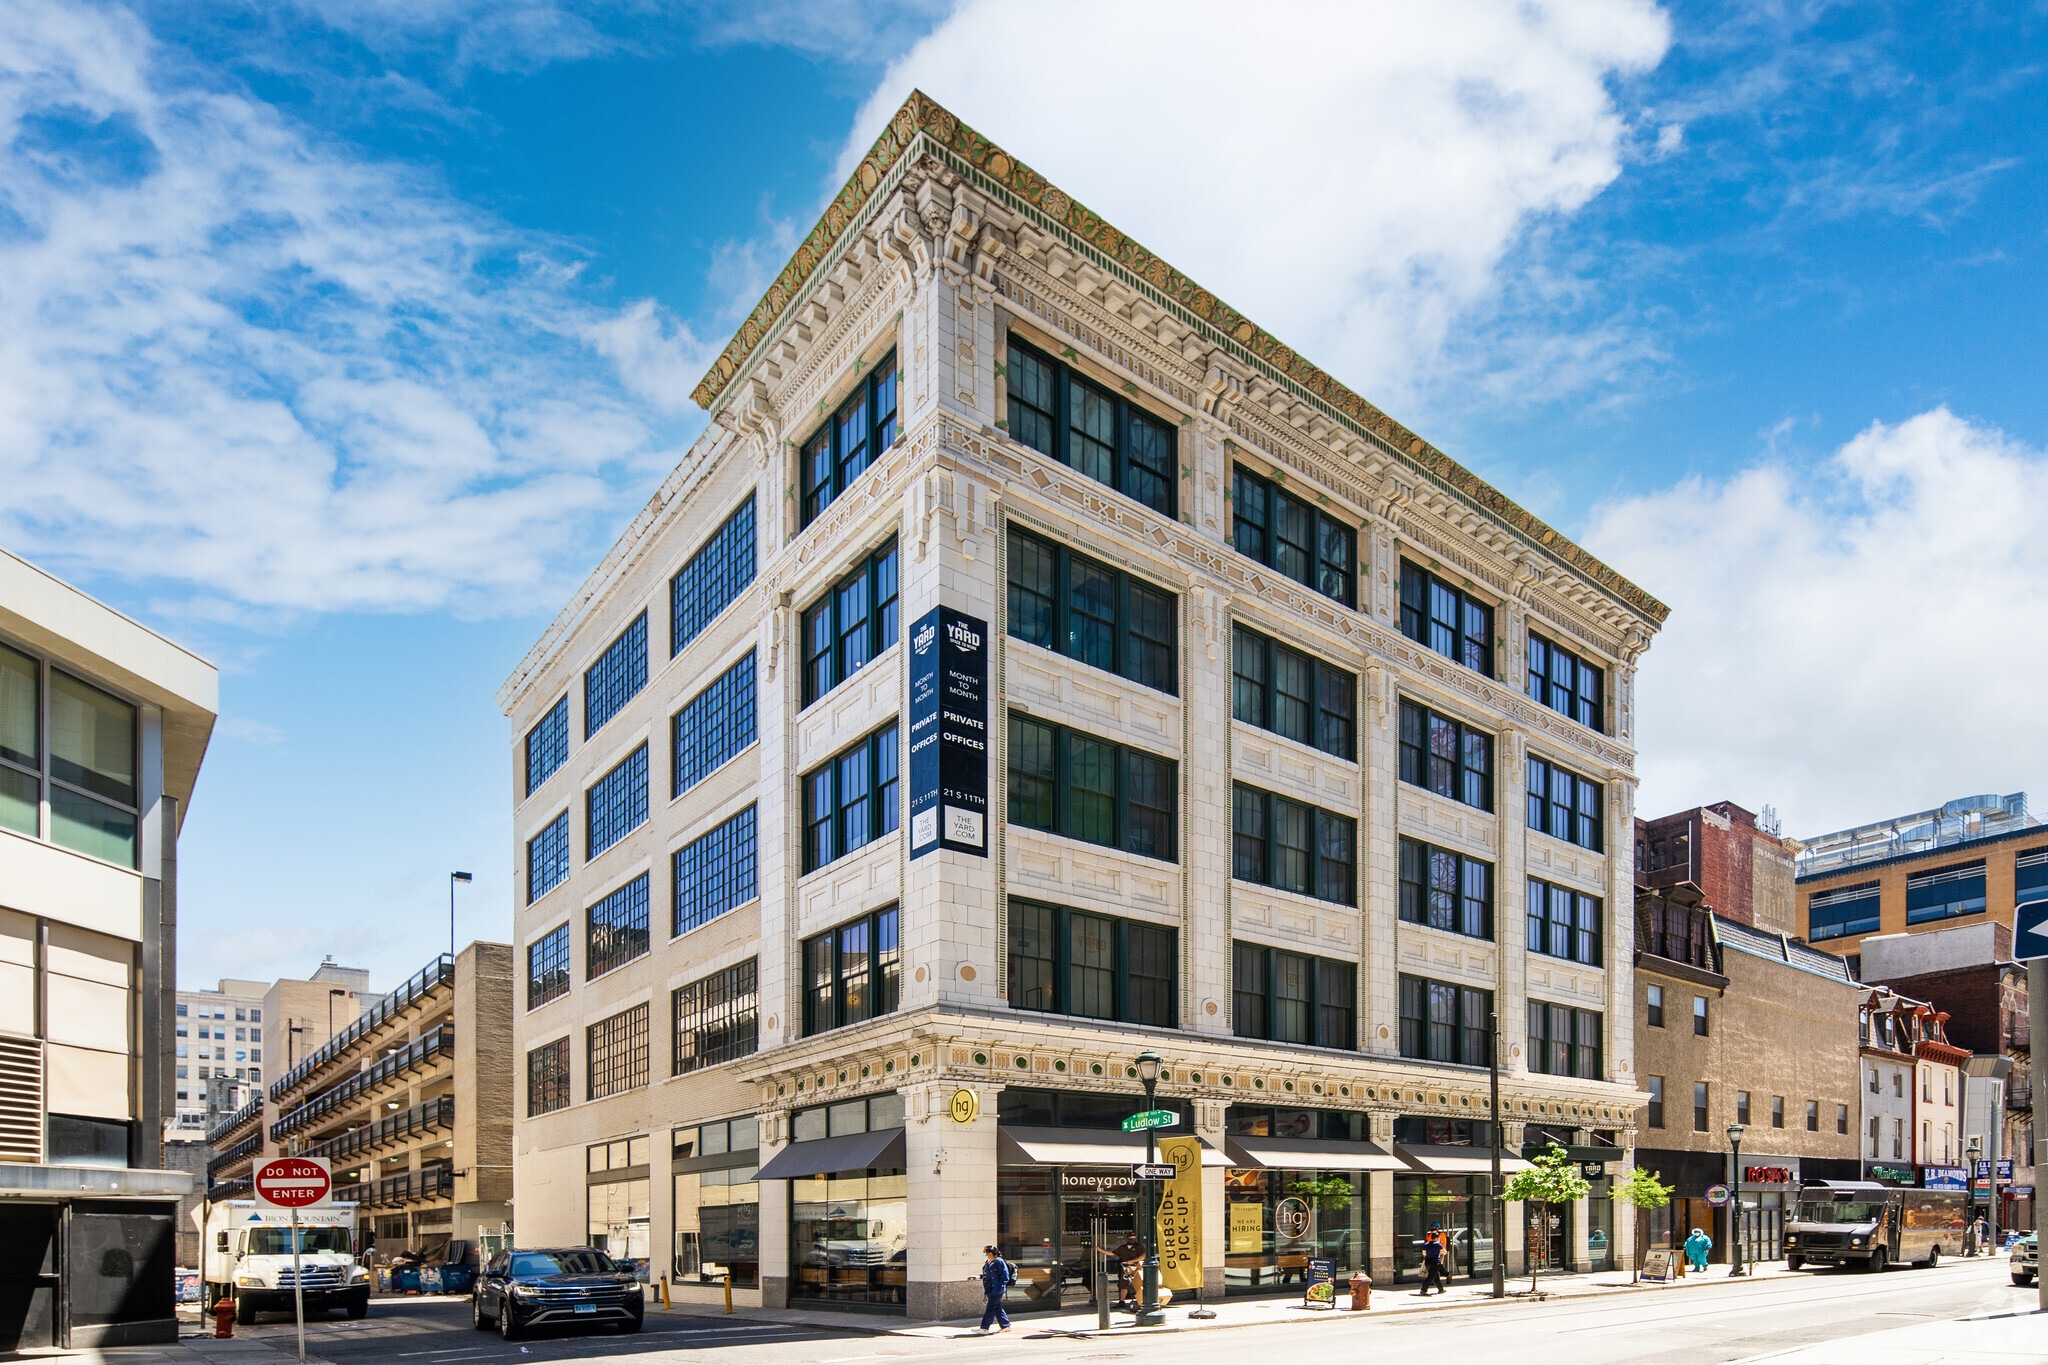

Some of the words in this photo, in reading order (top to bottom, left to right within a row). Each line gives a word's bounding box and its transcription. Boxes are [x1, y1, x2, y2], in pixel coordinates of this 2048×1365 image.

[920, 623, 928, 632] THE
[957, 621, 968, 630] THE
[913, 625, 935, 649] YARD
[947, 623, 980, 646] YARD
[915, 671, 934, 688] MONTH
[950, 671, 978, 685] MONTH
[958, 681, 969, 690] TO
[915, 687, 934, 704] MONTH
[920, 683, 928, 692] TO
[950, 686, 978, 701] MONTH
[911, 711, 938, 733] PRIVATE
[943, 710, 984, 730] PRIVATE
[911, 732, 938, 753] OFFICES
[943, 732, 984, 750] OFFICES
[912, 798, 919, 808] 21
[919, 796, 924, 804] S
[924, 788, 938, 801] 11TH
[943, 788, 954, 797] 21
[956, 790, 962, 799] S
[964, 793, 985, 805] 11TH
[919, 816, 929, 826] THE
[953, 821, 975, 833] YARD
[957, 815, 972, 825] THE
[918, 823, 931, 834] YARD
[954, 830, 975, 840] .COM
[1754, 859, 1794, 902] Society
[1763, 890, 1785, 922] Hill
[955, 1097, 969, 1116] hg
[1130, 1117, 1160, 1129] Ludlow
[1162, 1114, 1171, 1124] St
[1172, 1151, 1187, 1167] hg
[266, 1168, 284, 1176] DO
[292, 1167, 318, 1176] NOT
[1584, 1164, 1601, 1172] YARD
[1937, 1168, 1966, 1182] DIAMONDS
[1062, 1172, 1137, 1189] honeygrow
[272, 1189, 315, 1199] ENTER
[1283, 1206, 1303, 1229] hg
[1162, 1190, 1177, 1269] CURBSIDE
[1177, 1196, 1191, 1261] PICK-UP
